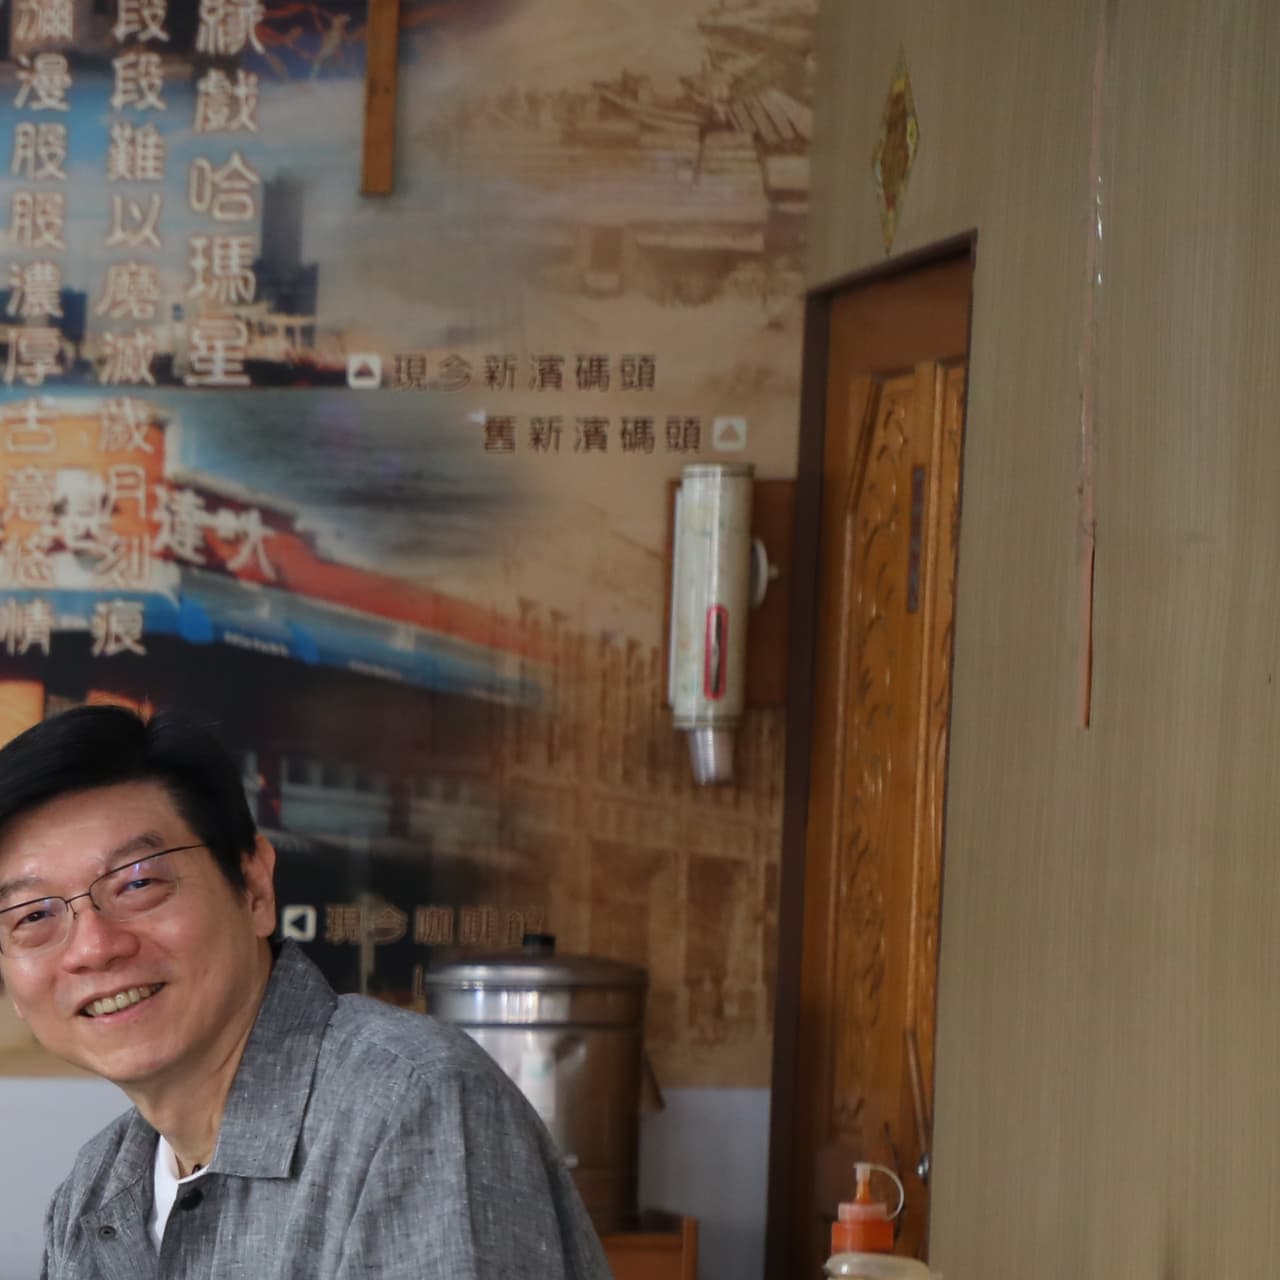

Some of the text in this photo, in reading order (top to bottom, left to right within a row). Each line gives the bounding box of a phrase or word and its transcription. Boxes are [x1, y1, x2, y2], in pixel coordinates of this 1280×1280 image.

[392, 353, 657, 392] 現今新濱碼頭
[483, 415, 701, 454] 舊新濱碼頭
